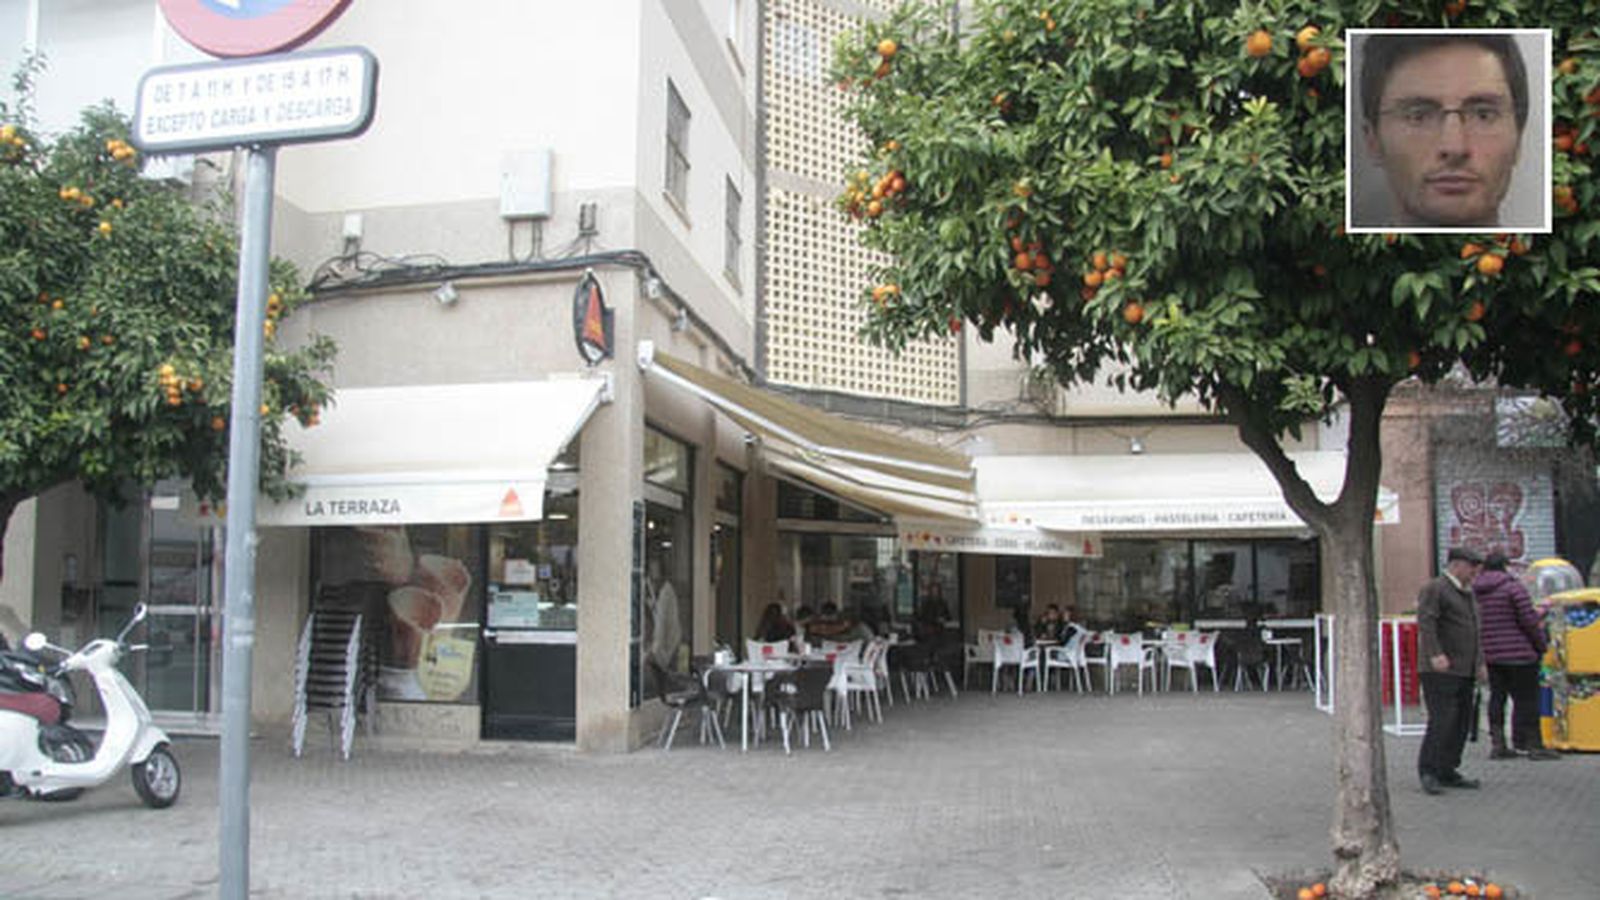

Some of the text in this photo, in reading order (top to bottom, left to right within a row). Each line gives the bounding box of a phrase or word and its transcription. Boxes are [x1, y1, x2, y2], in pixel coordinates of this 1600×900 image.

[154, 83, 172, 103] DE
[256, 73, 275, 92] DE
[146, 111, 205, 135] EXCEPTO
[210, 105, 257, 128] CARGA
[277, 97, 353, 122] DESCARGA
[306, 499, 401, 516] LA TERRAZA
